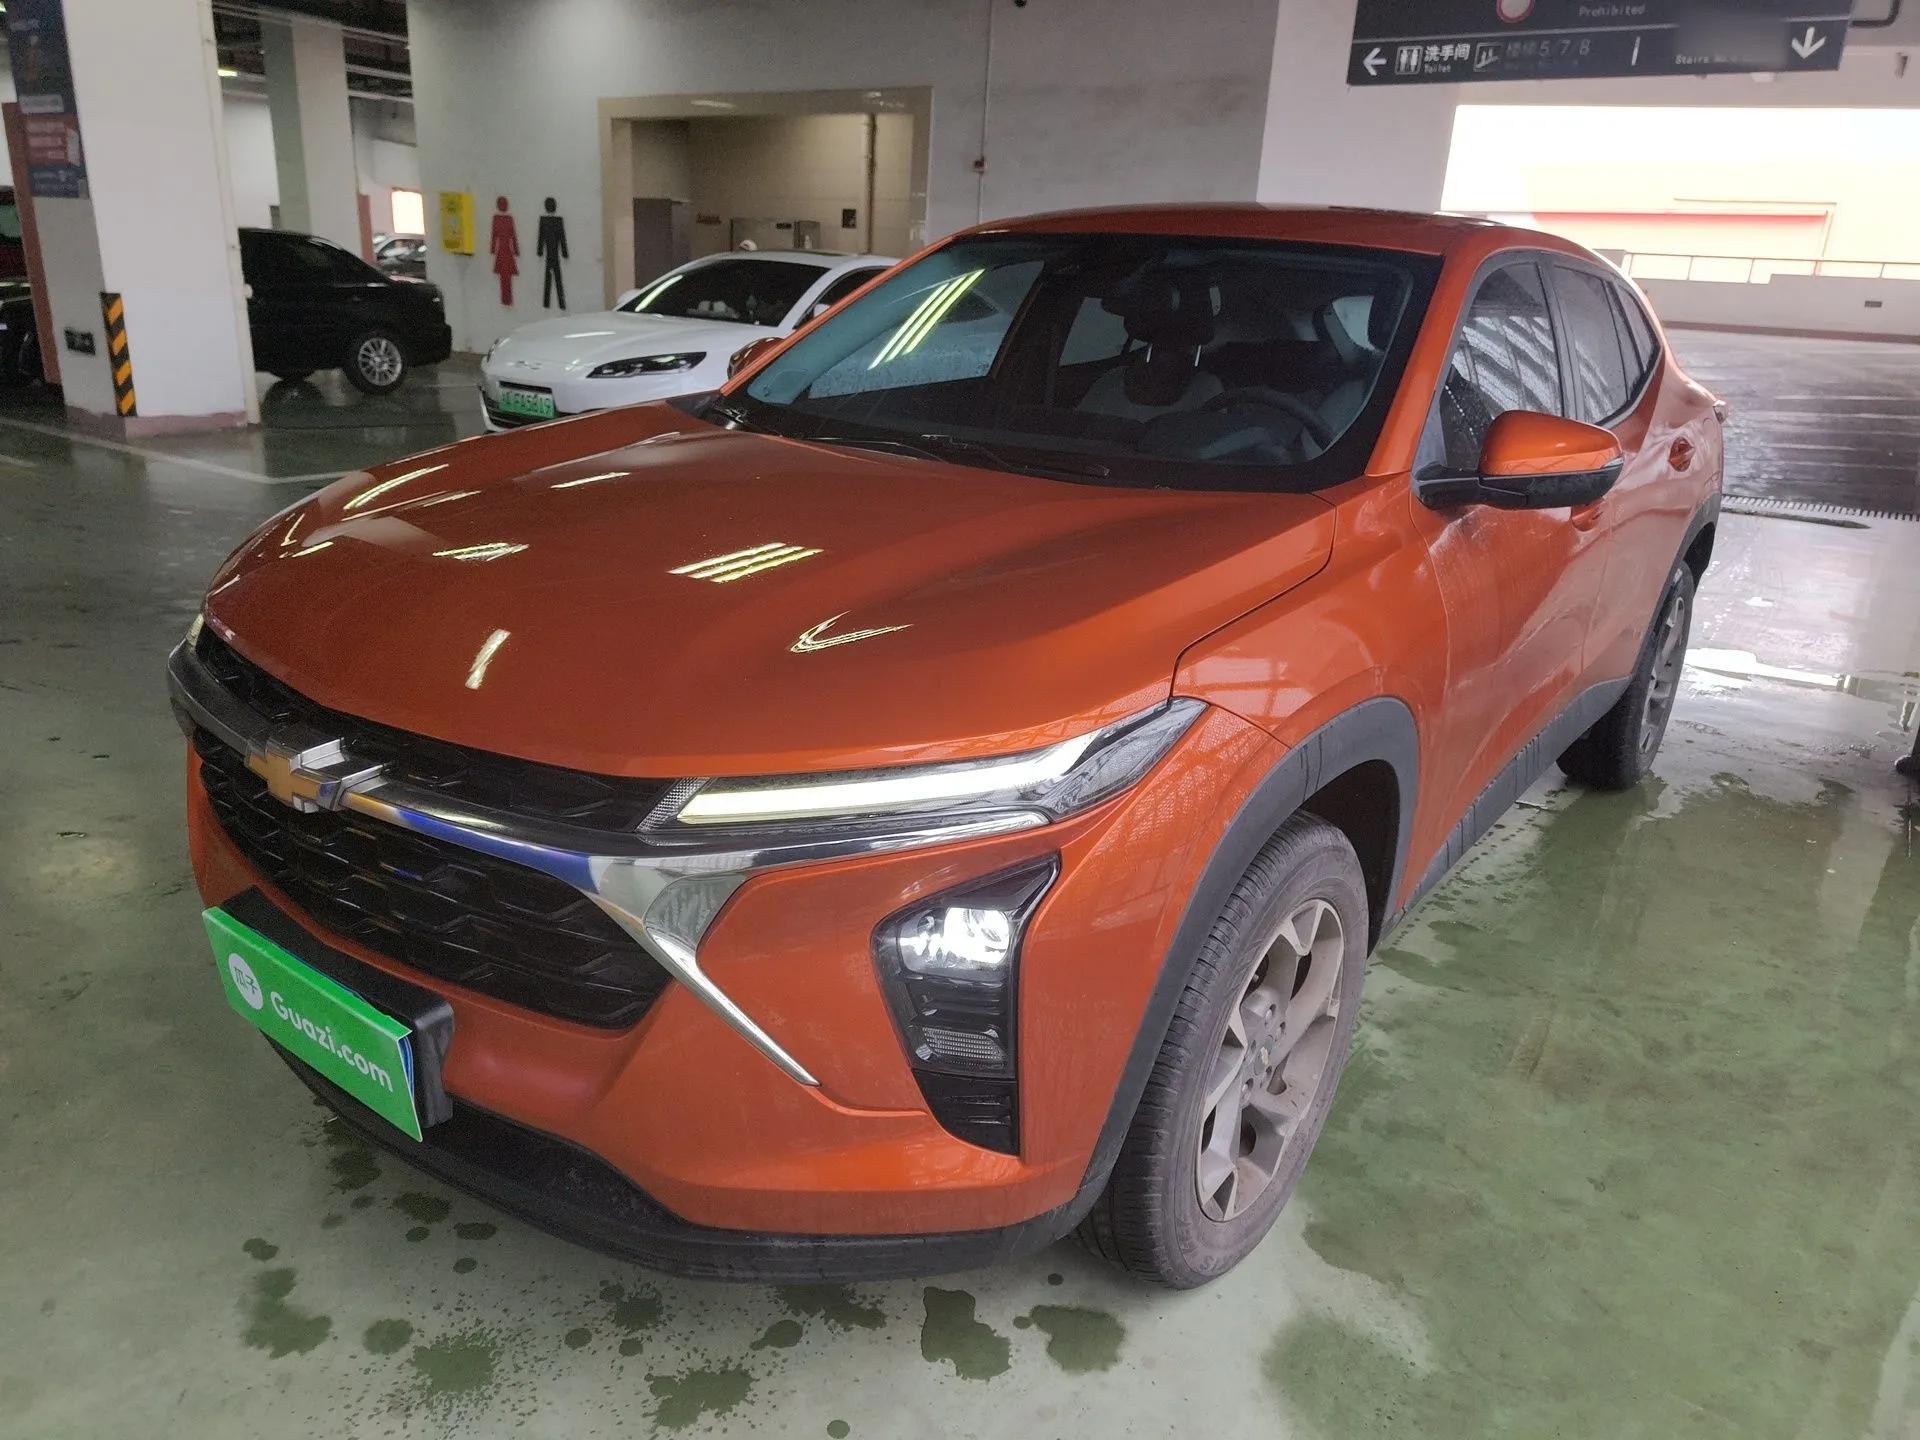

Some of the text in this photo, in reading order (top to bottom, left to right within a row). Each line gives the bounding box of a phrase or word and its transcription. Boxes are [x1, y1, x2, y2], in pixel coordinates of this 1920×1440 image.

[1578, 3, 1645, 17] Prohibited
[1424, 43, 1471, 62] 洗手间
[1674, 54, 1710, 65] Stairs
[233, 966, 258, 995] 瓜子
[270, 991, 394, 1092] Guazi.com
